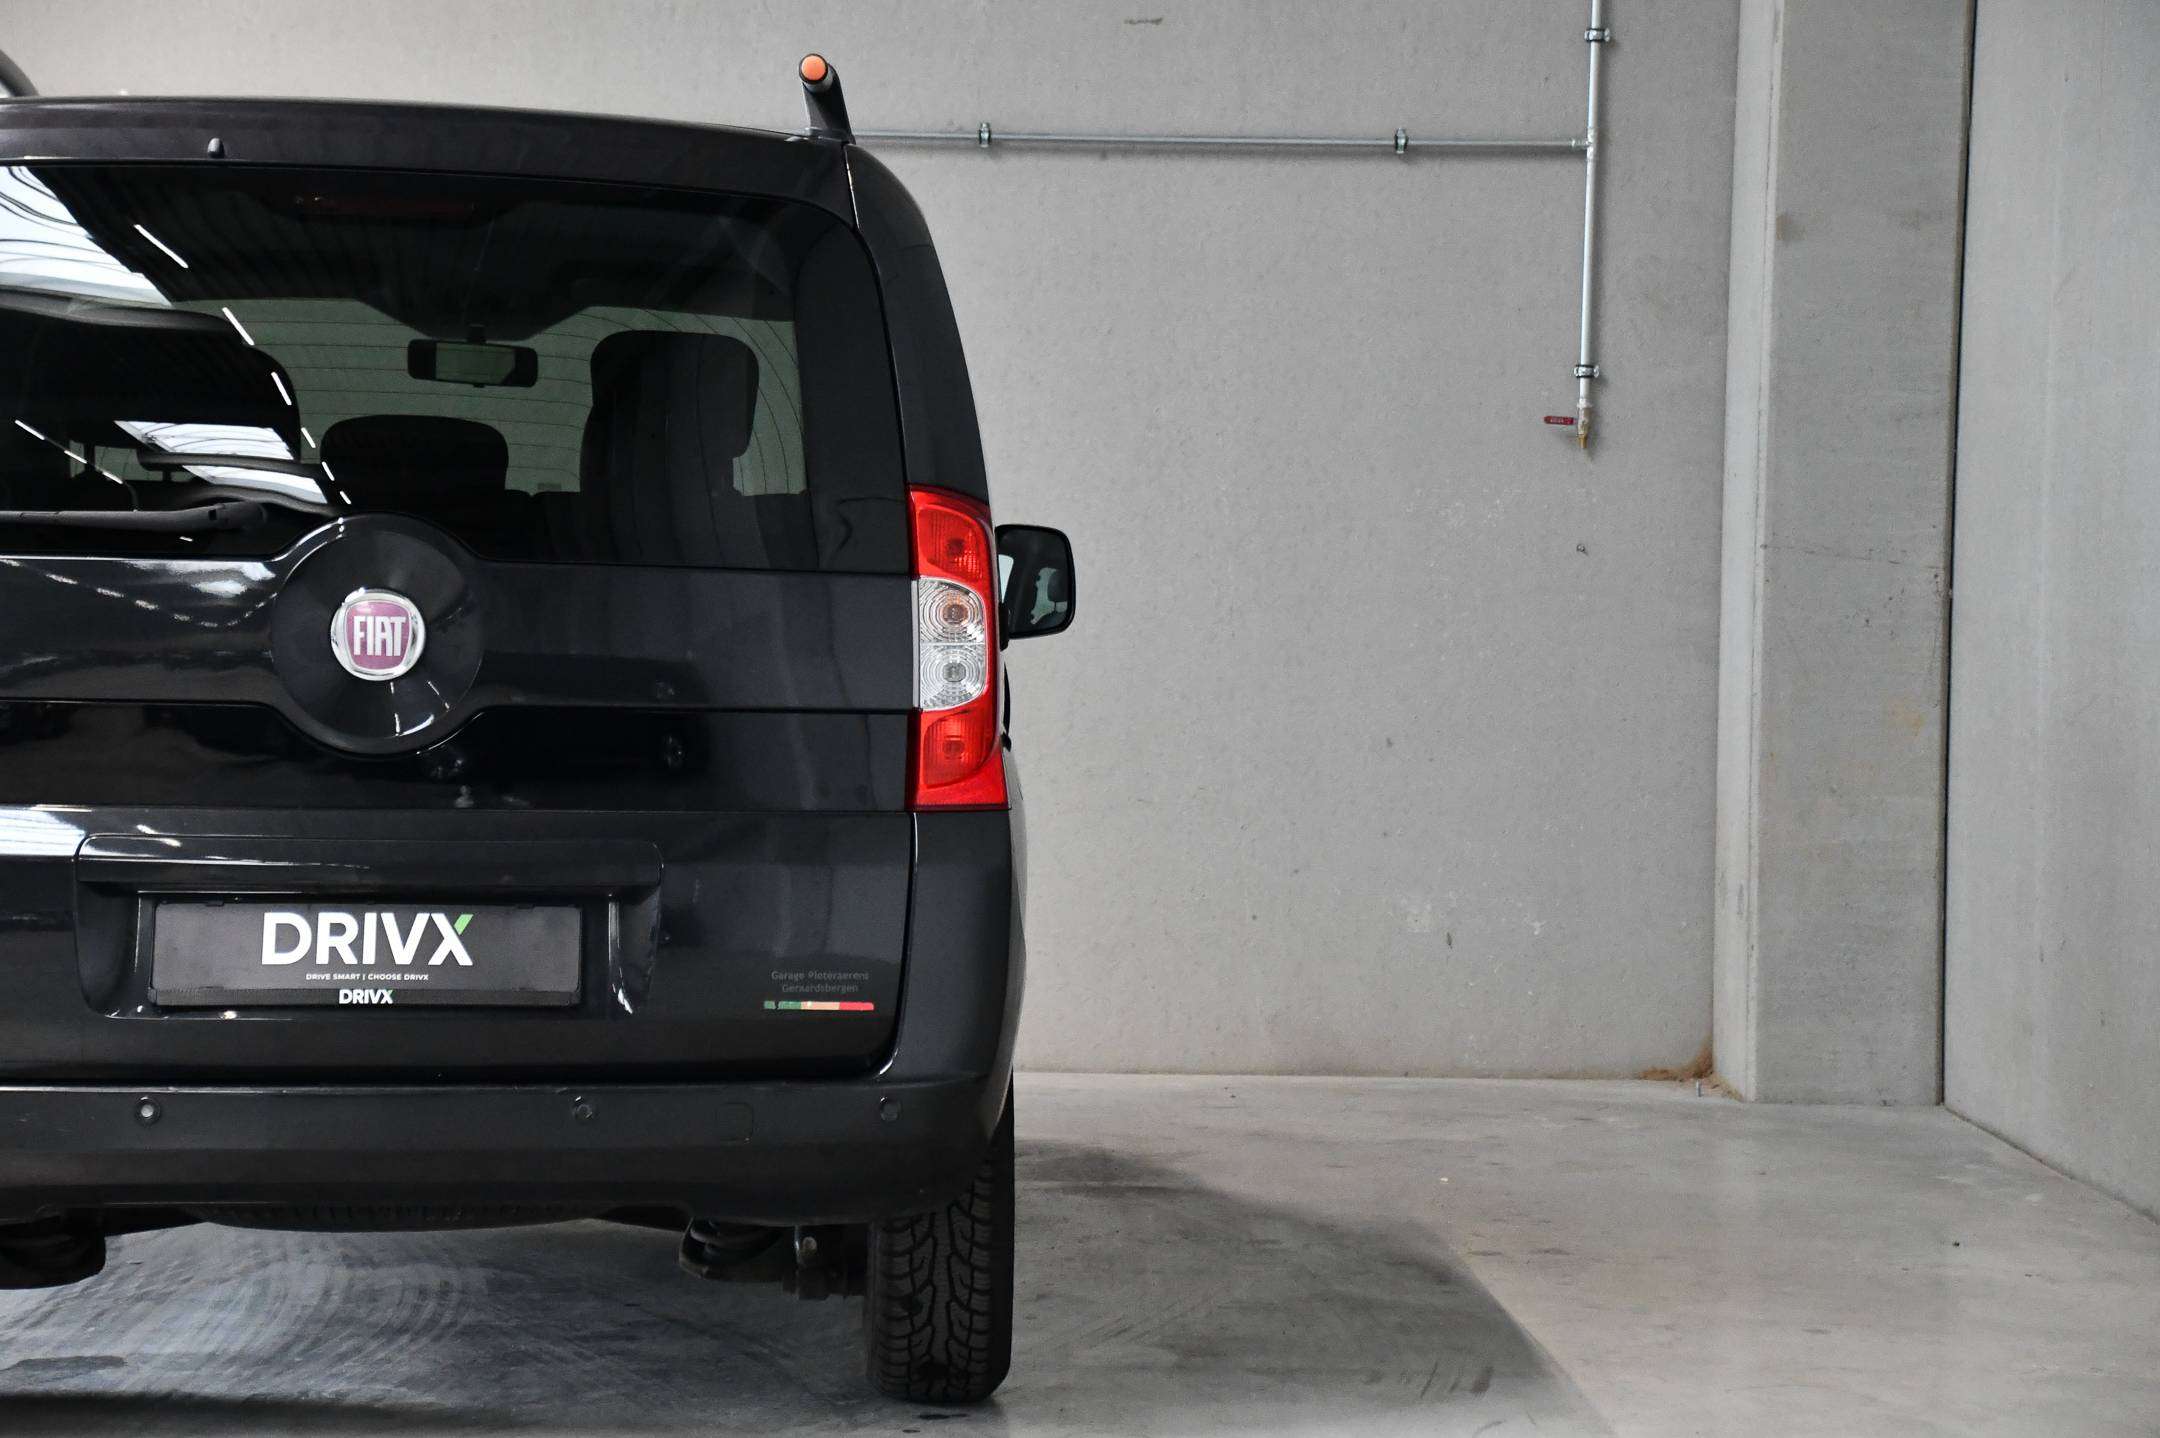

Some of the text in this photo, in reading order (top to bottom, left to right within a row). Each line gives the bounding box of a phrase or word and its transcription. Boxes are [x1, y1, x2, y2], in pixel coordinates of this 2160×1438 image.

[353, 615, 406, 657] FIAT
[261, 912, 474, 966] DRIVX
[305, 973, 331, 981] DRIVE
[332, 973, 360, 981] SMART
[367, 973, 402, 981] CHOOSE
[771, 970, 805, 981] Garage
[338, 988, 394, 1005] DRIVX
